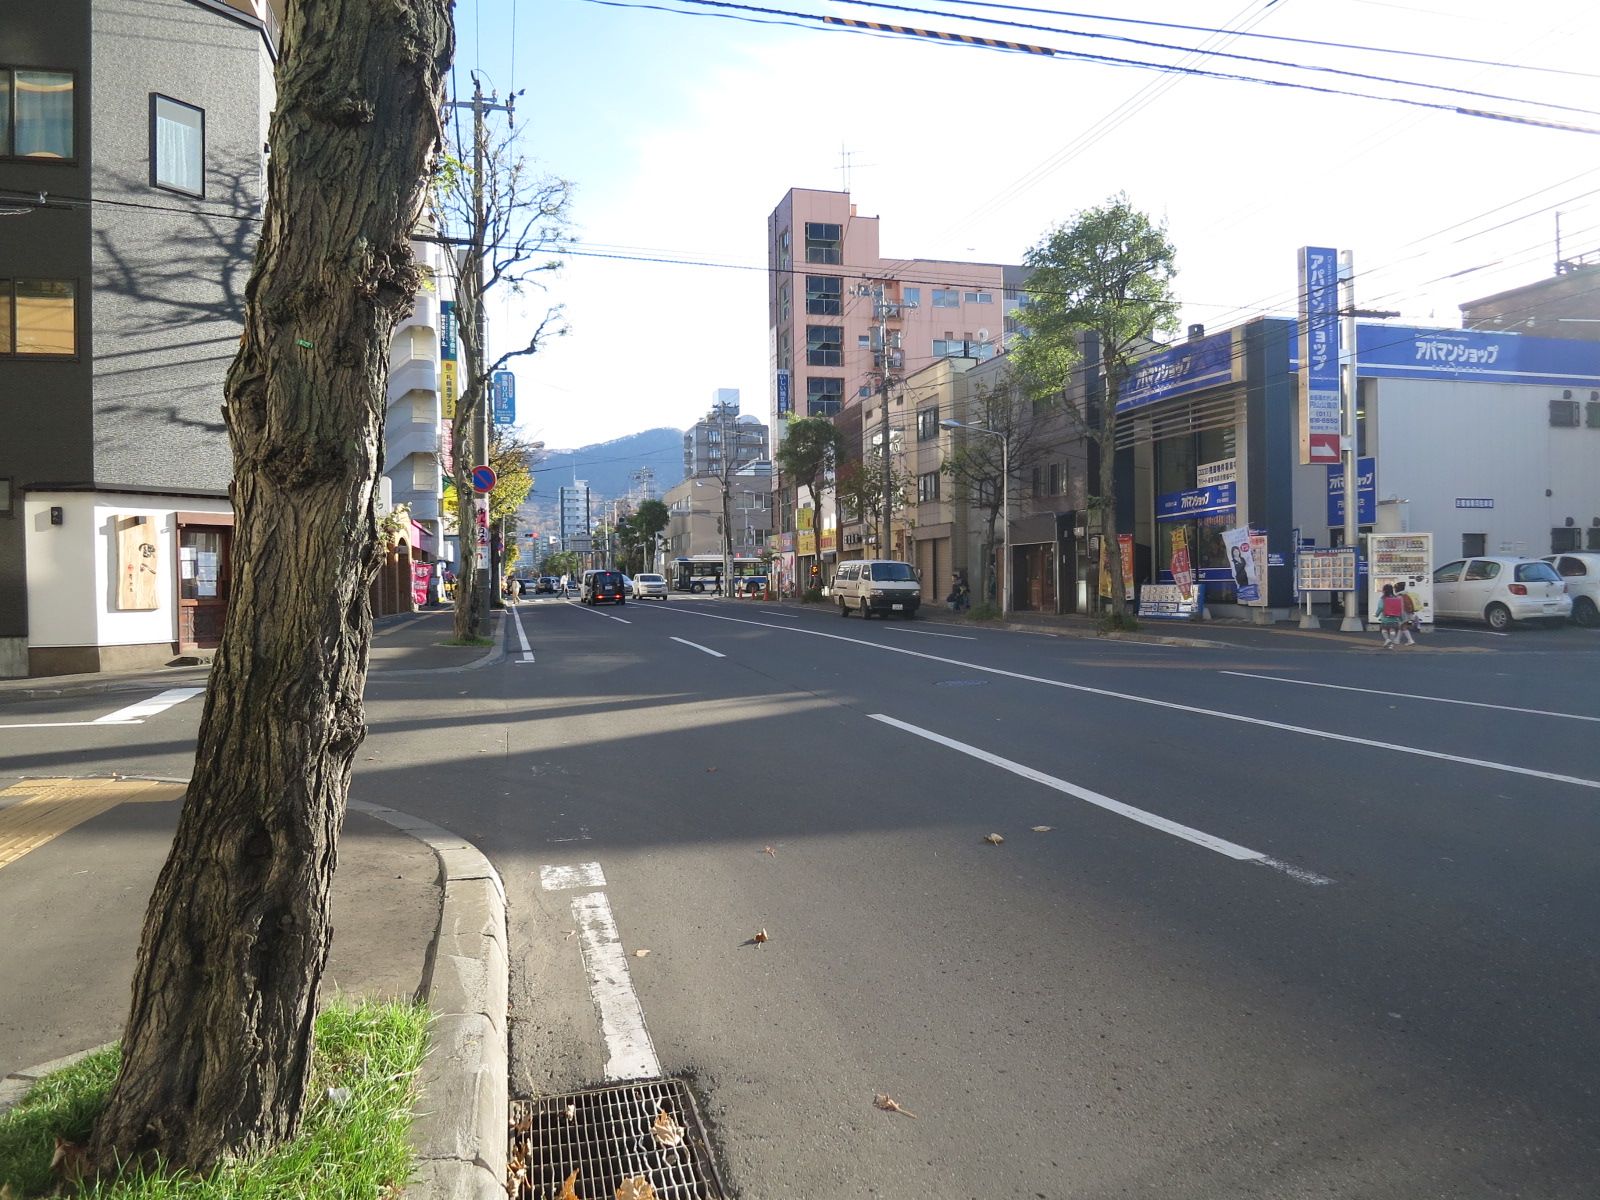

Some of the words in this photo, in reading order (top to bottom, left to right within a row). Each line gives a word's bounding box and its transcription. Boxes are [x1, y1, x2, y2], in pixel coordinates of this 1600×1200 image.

[1310, 254, 1328, 371] アパマンショップ
[1415, 341, 1499, 364] アパマンショップ
[1136, 354, 1191, 388] アパマンショップ
